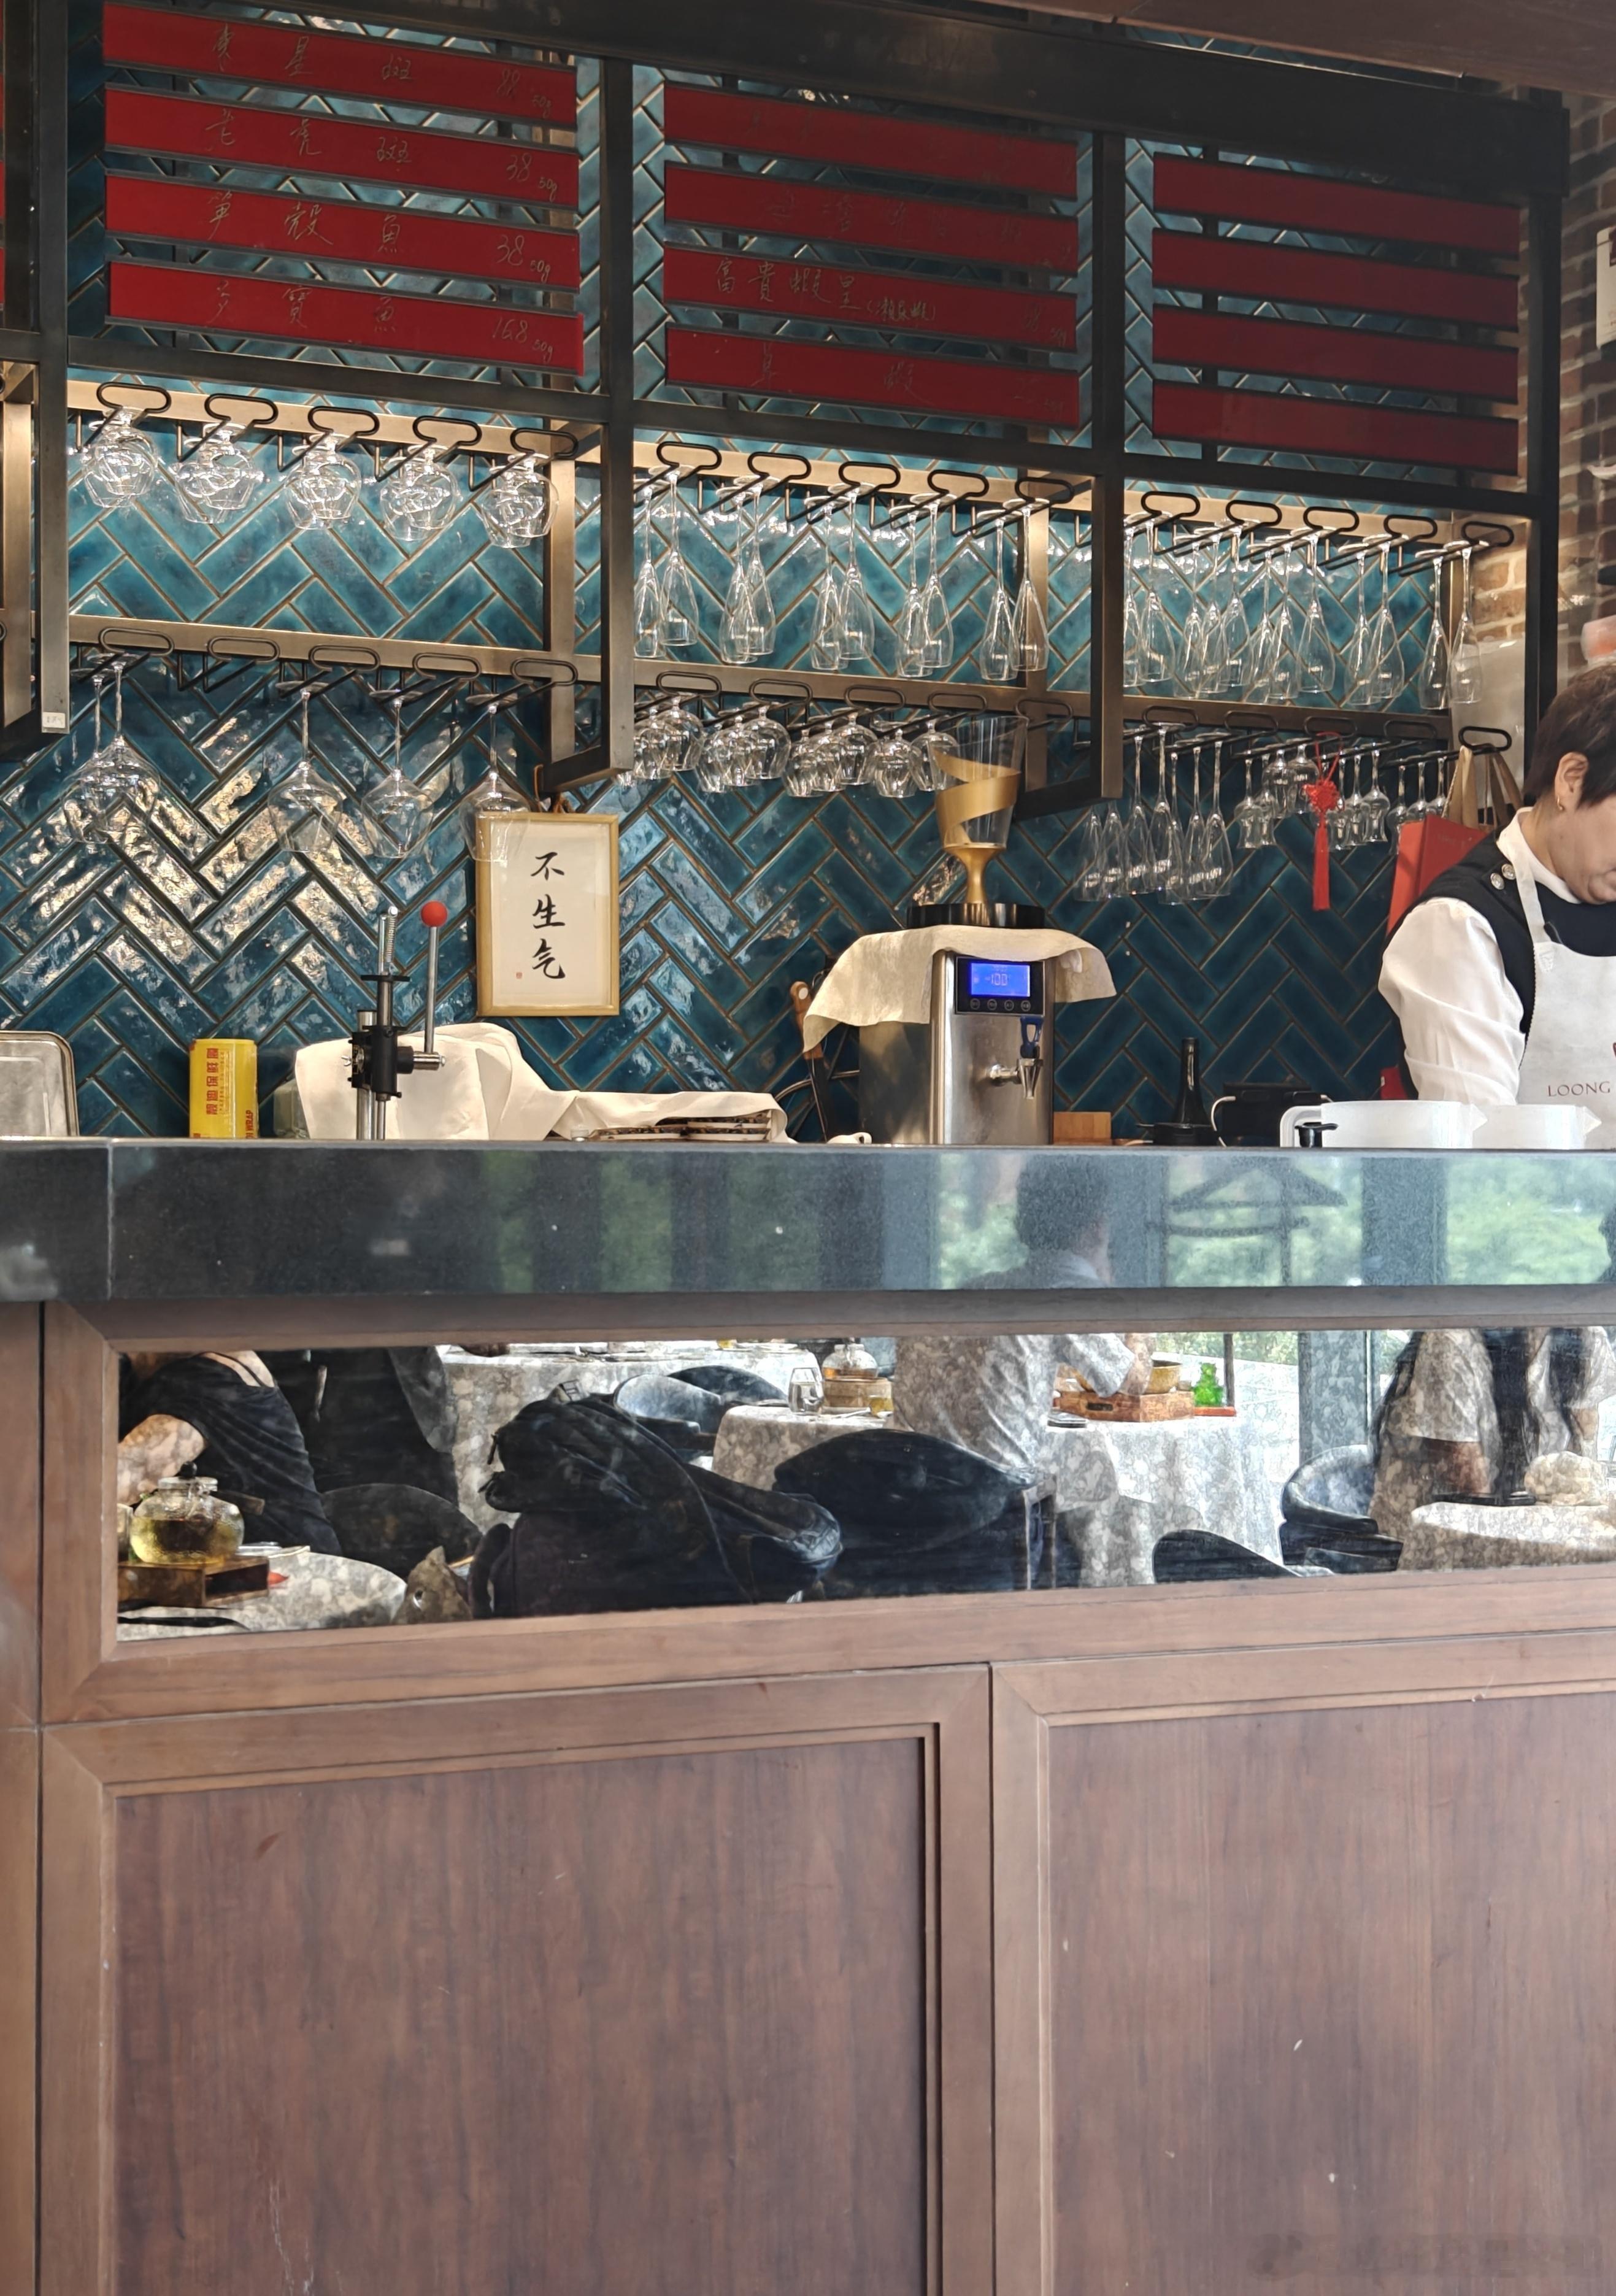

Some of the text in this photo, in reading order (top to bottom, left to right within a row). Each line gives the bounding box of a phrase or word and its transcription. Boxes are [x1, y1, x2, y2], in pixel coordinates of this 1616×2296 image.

[505, 152, 533, 183] 38
[537, 177, 559, 202] 50g
[496, 234, 526, 266] 38
[529, 259, 552, 281] 50g
[491, 314, 529, 343] 168
[531, 338, 555, 363] 50g
[530, 852, 566, 979] 不生气
[1547, 1081, 1611, 1097] LOONG
